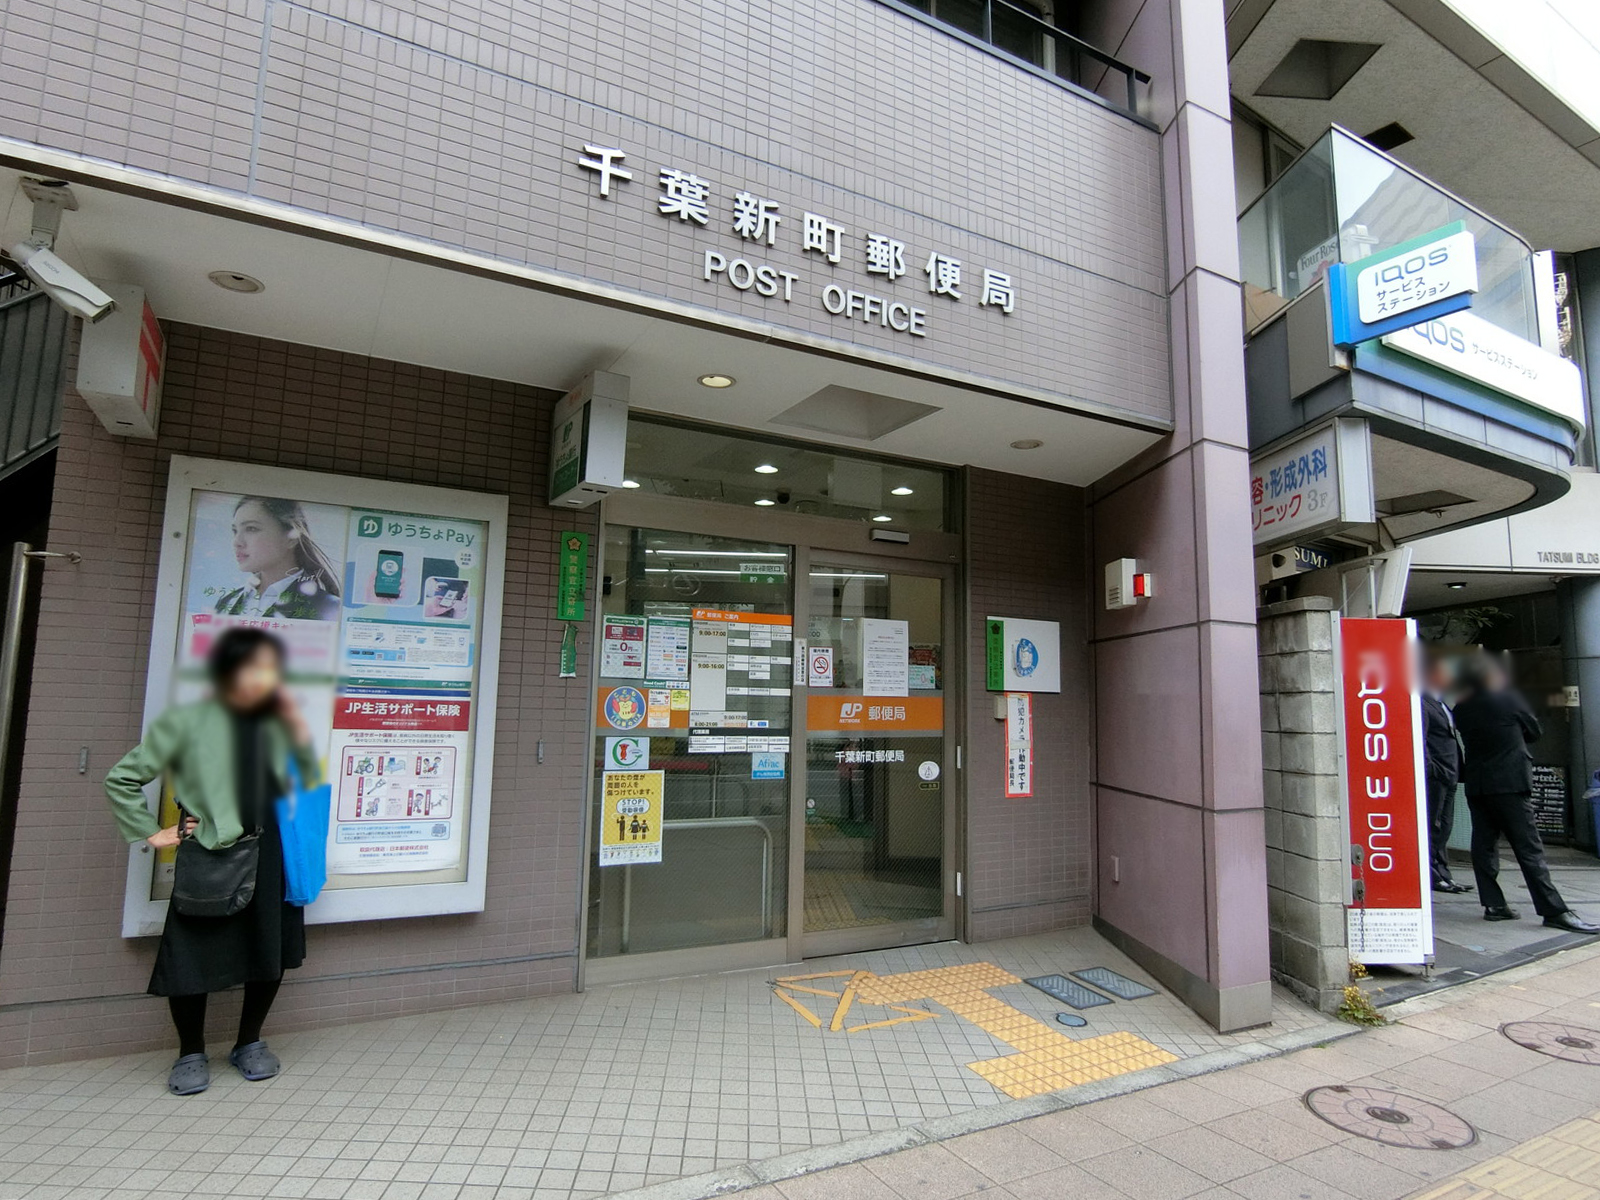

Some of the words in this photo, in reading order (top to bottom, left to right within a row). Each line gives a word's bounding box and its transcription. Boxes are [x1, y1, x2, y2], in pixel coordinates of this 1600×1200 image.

[579, 144, 1015, 314] 千葉新町郵便局
[1301, 252, 1320, 271] Four
[1375, 247, 1448, 287] IQOS
[704, 250, 799, 302] POST
[822, 284, 927, 337] OFFICE
[1376, 277, 1425, 301] サービス
[1377, 281, 1450, 314] ステーション
[1406, 319, 1465, 354] QOS
[1307, 488, 1328, 512] 3F
[388, 522, 475, 547] ゆうちょPay
[1537, 551, 1573, 563] TATSUMI
[345, 702, 461, 717] JP生活サポート保険
[868, 706, 906, 721] 郵便局
[1358, 655, 1389, 762] QOS
[757, 759, 780, 769] Aflac
[835, 750, 905, 763] 千葉新町郵便局
[1366, 776, 1390, 799] 3
[1367, 813, 1393, 872] DUO
